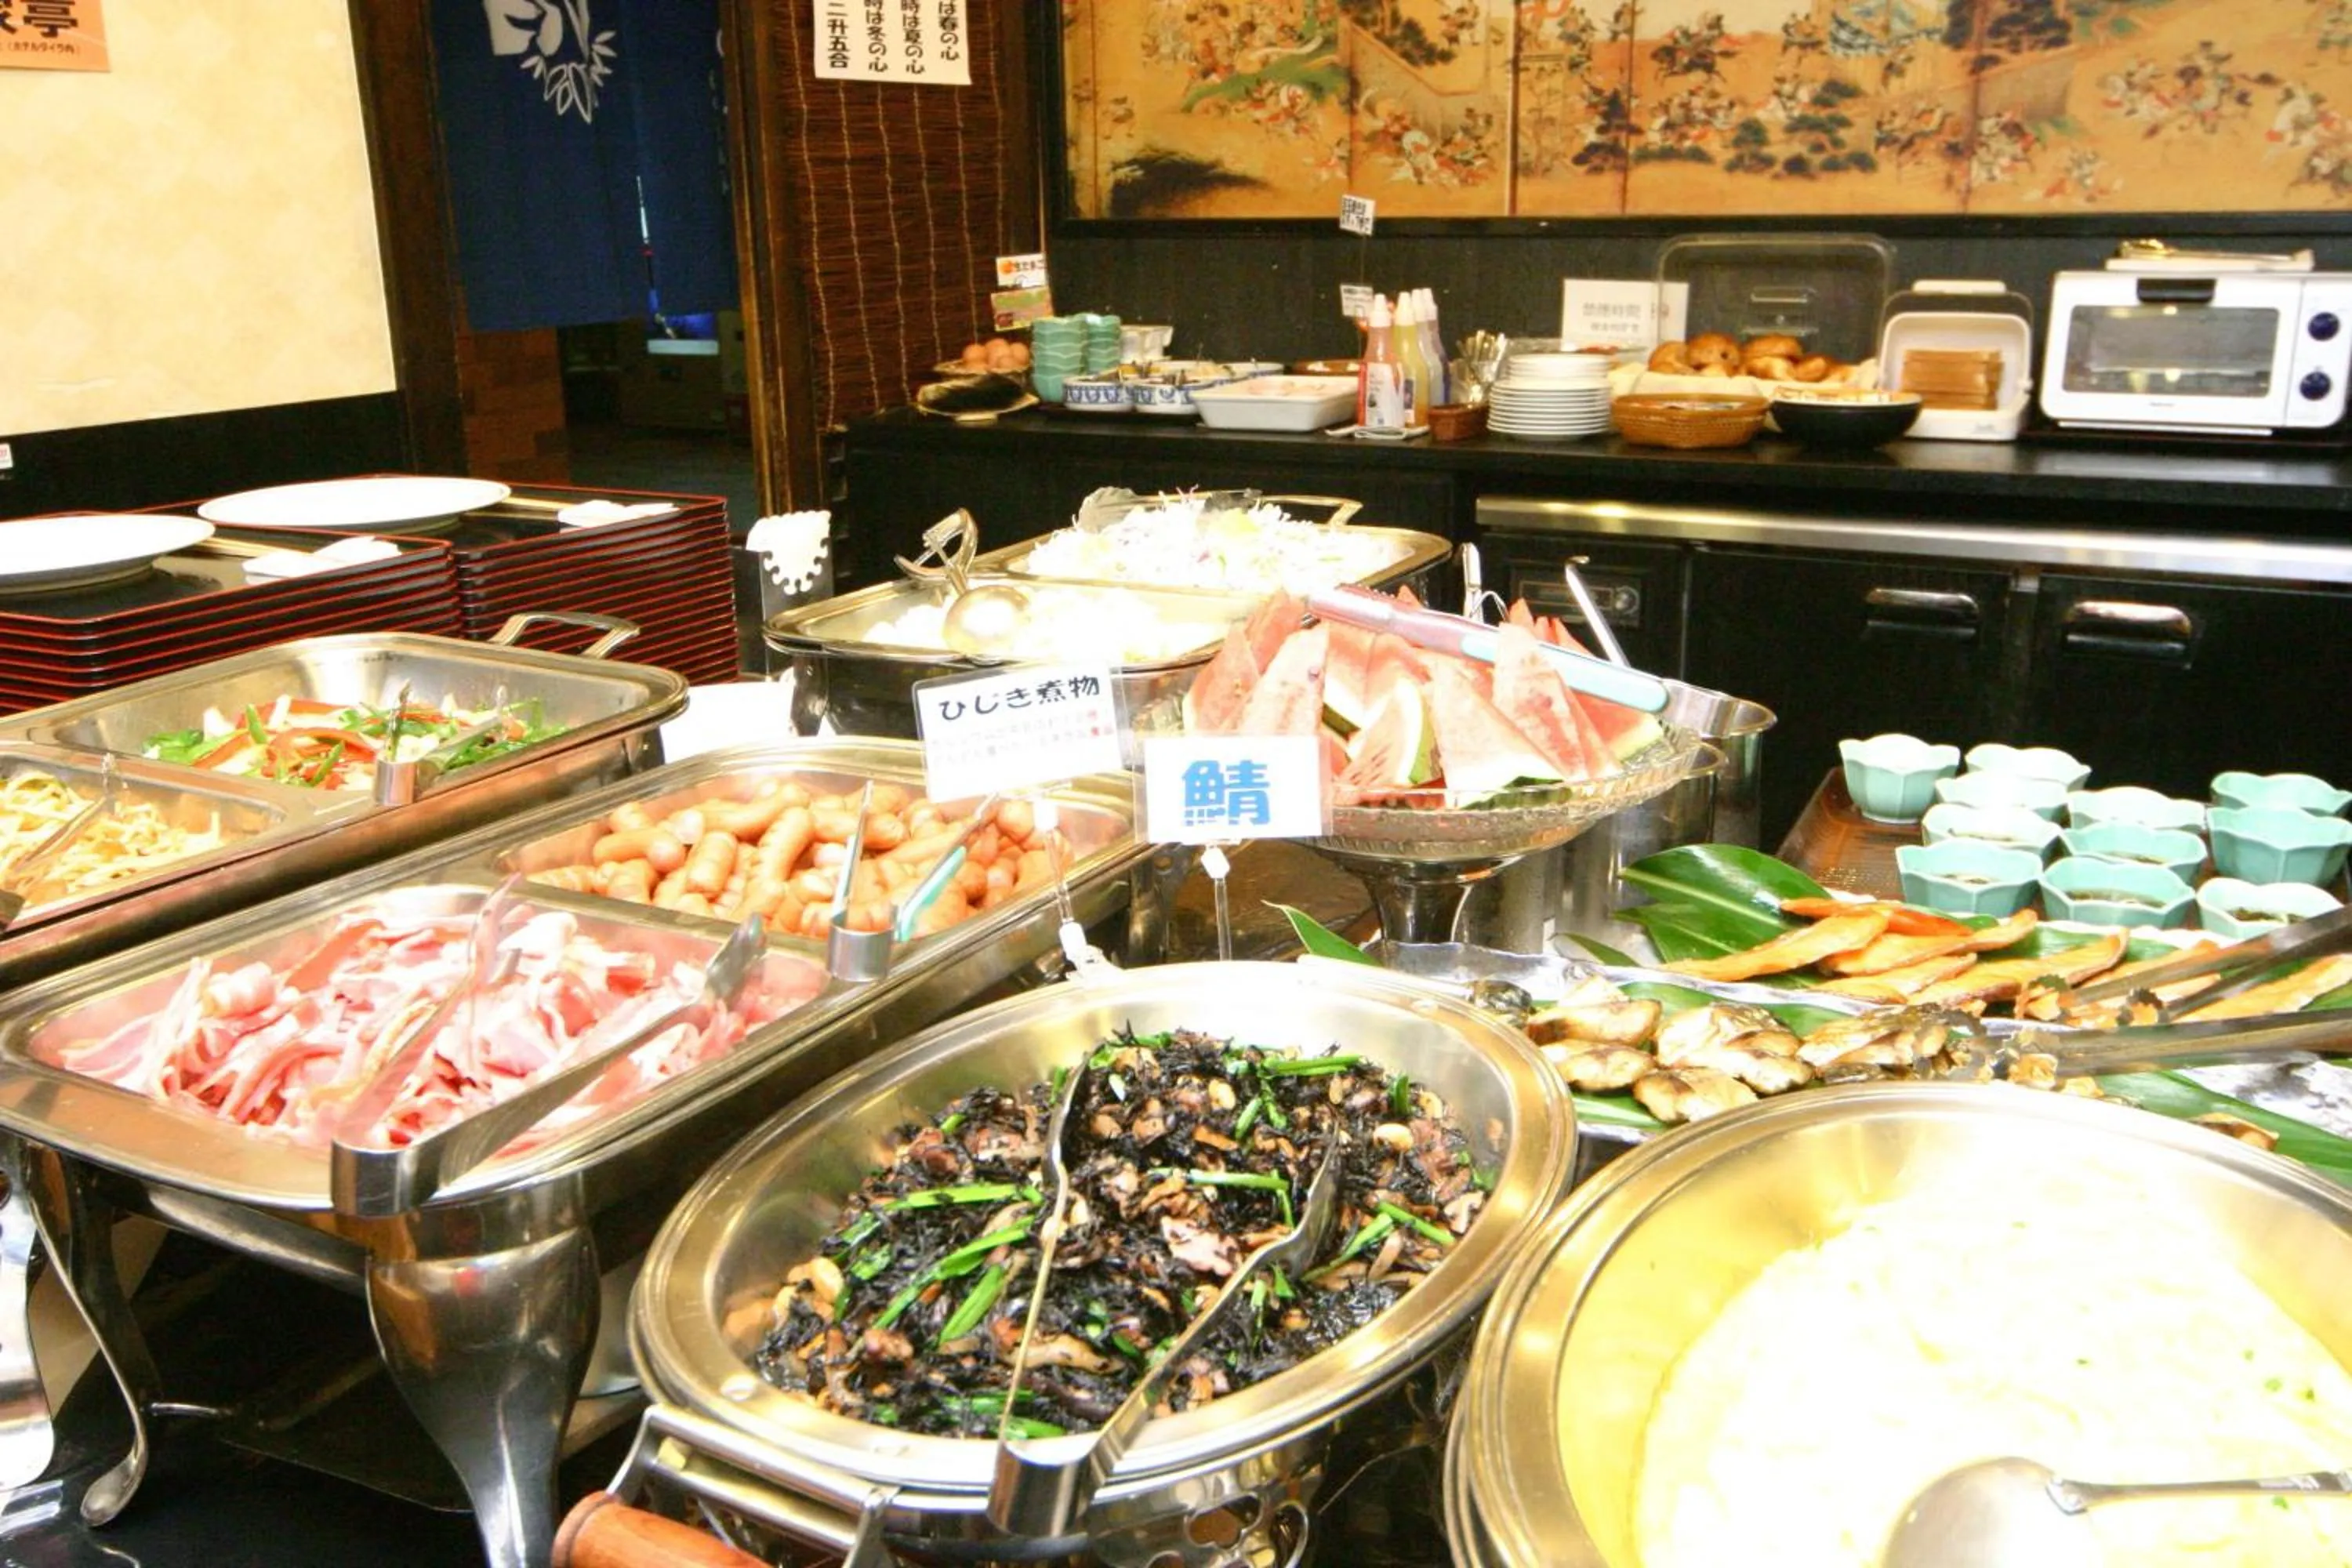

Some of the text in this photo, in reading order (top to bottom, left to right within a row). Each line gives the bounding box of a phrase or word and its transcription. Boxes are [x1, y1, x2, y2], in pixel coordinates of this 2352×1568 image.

[0, 0, 78, 38] 亭
[826, 2, 851, 69] 二升五合
[938, 675, 1100, 720] ひじき煮物
[1181, 759, 1270, 826] 鯖
